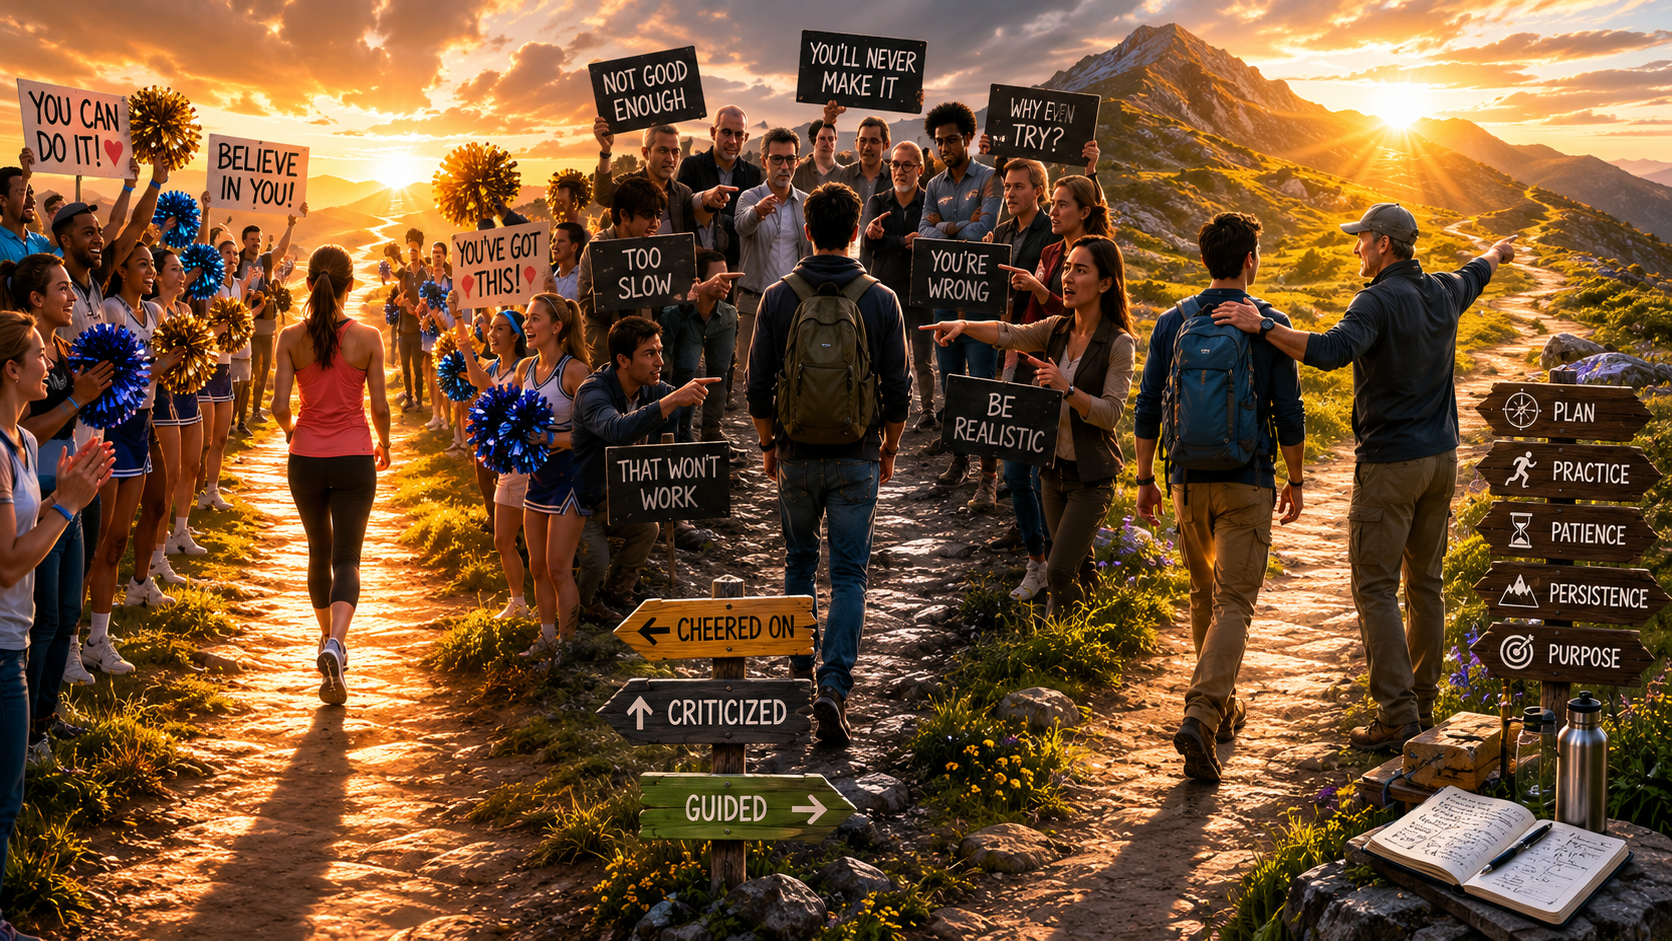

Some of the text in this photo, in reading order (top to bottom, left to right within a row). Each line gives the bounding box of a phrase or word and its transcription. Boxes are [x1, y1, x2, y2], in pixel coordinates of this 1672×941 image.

[810, 41, 917, 74] YOU'LL NEVER
[603, 59, 688, 95] NOT GOOD
[822, 71, 898, 99] MAKE IT
[28, 90, 120, 131] YOU CAN
[614, 88, 686, 122] ENOUGH
[1010, 97, 1043, 120] WHY
[37, 130, 102, 167] DO IT!
[1012, 123, 1065, 152] TRY?
[218, 142, 298, 176] BELIEVE
[221, 175, 295, 208] IN YOU!
[456, 231, 541, 264] YOU'VE GOT
[622, 247, 662, 270] TOO
[930, 249, 989, 275] YOU'RE
[474, 265, 520, 296] THIS!
[618, 273, 672, 300] SLOW
[928, 276, 990, 302] WRONG
[987, 392, 1015, 418] BE
[1553, 401, 1595, 423] PLAN
[953, 417, 1045, 453] REALISTIC
[617, 454, 720, 482] THAT WON'T
[1553, 461, 1630, 485] PRACTICE
[640, 485, 699, 510] WORK
[1551, 521, 1626, 546] PATIENCE
[1549, 583, 1649, 609] PERSISTENCE
[677, 614, 795, 643] CHEERED ON
[1548, 644, 1621, 668] PURPOSE
[667, 698, 787, 726] CRITICIZED
[685, 793, 768, 822] GUIDED
